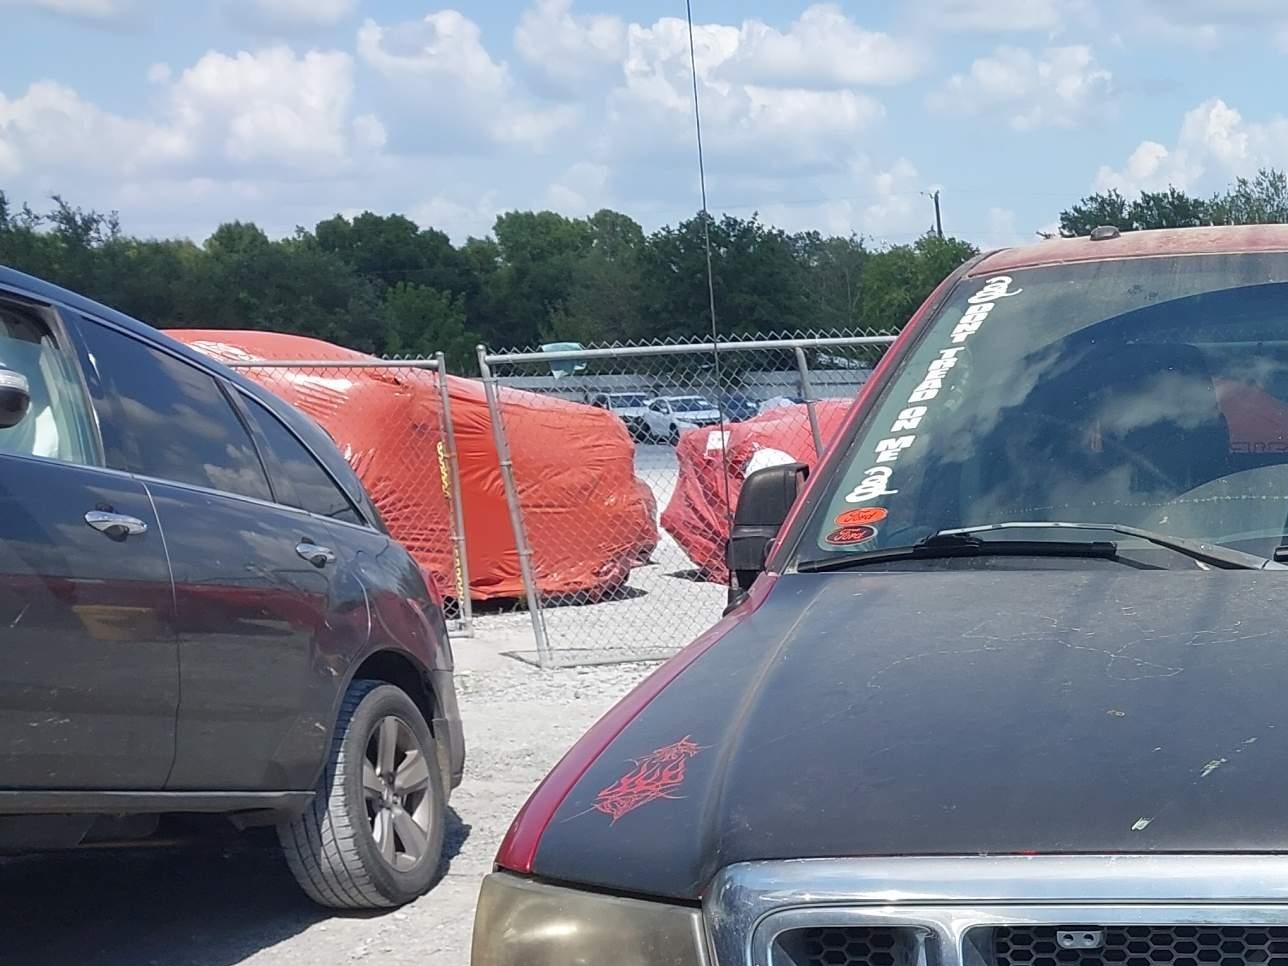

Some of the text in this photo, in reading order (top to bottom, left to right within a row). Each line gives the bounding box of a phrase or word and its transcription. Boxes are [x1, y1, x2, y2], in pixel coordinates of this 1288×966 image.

[874, 302, 995, 464] DONT TREAD ON ME
[834, 528, 867, 541] Ford
